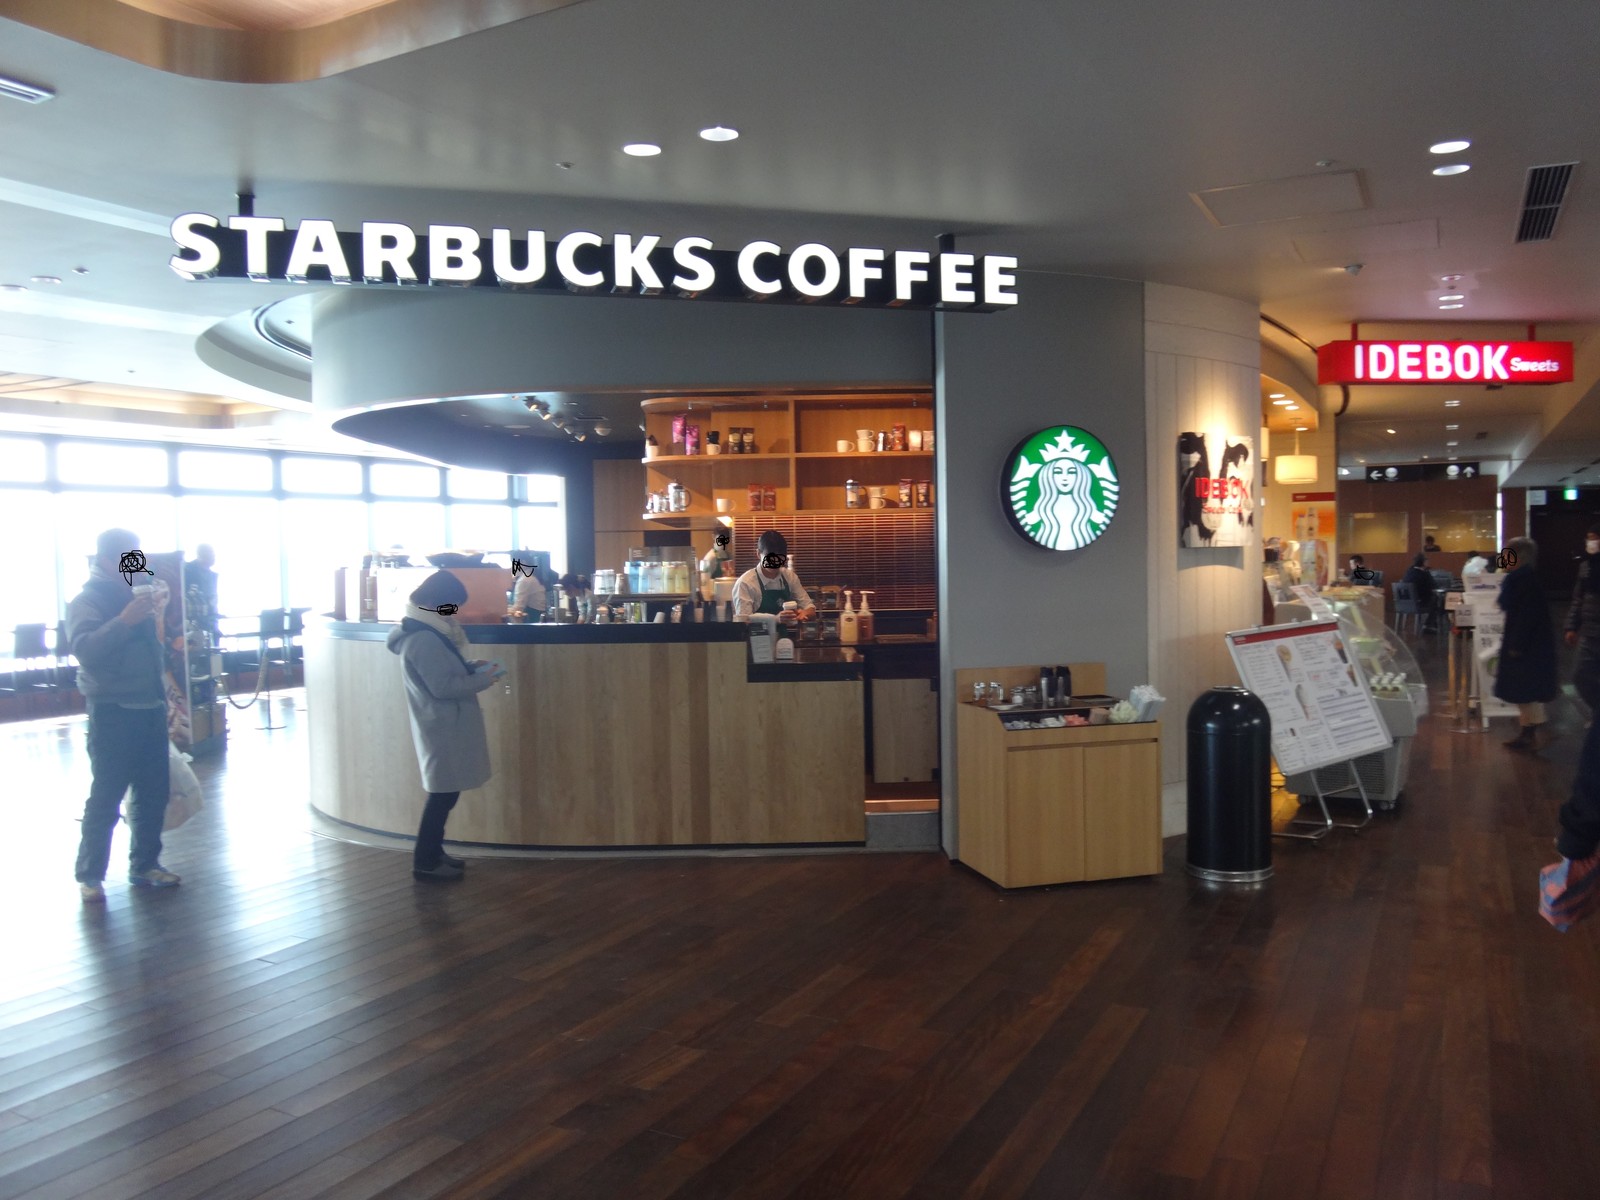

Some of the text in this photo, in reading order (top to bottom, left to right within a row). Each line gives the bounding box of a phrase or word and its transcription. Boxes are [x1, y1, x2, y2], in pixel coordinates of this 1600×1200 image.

[169, 212, 1019, 306] STARBUCKS COFFEE
[1354, 344, 1559, 380] IDEBOK Sweets
